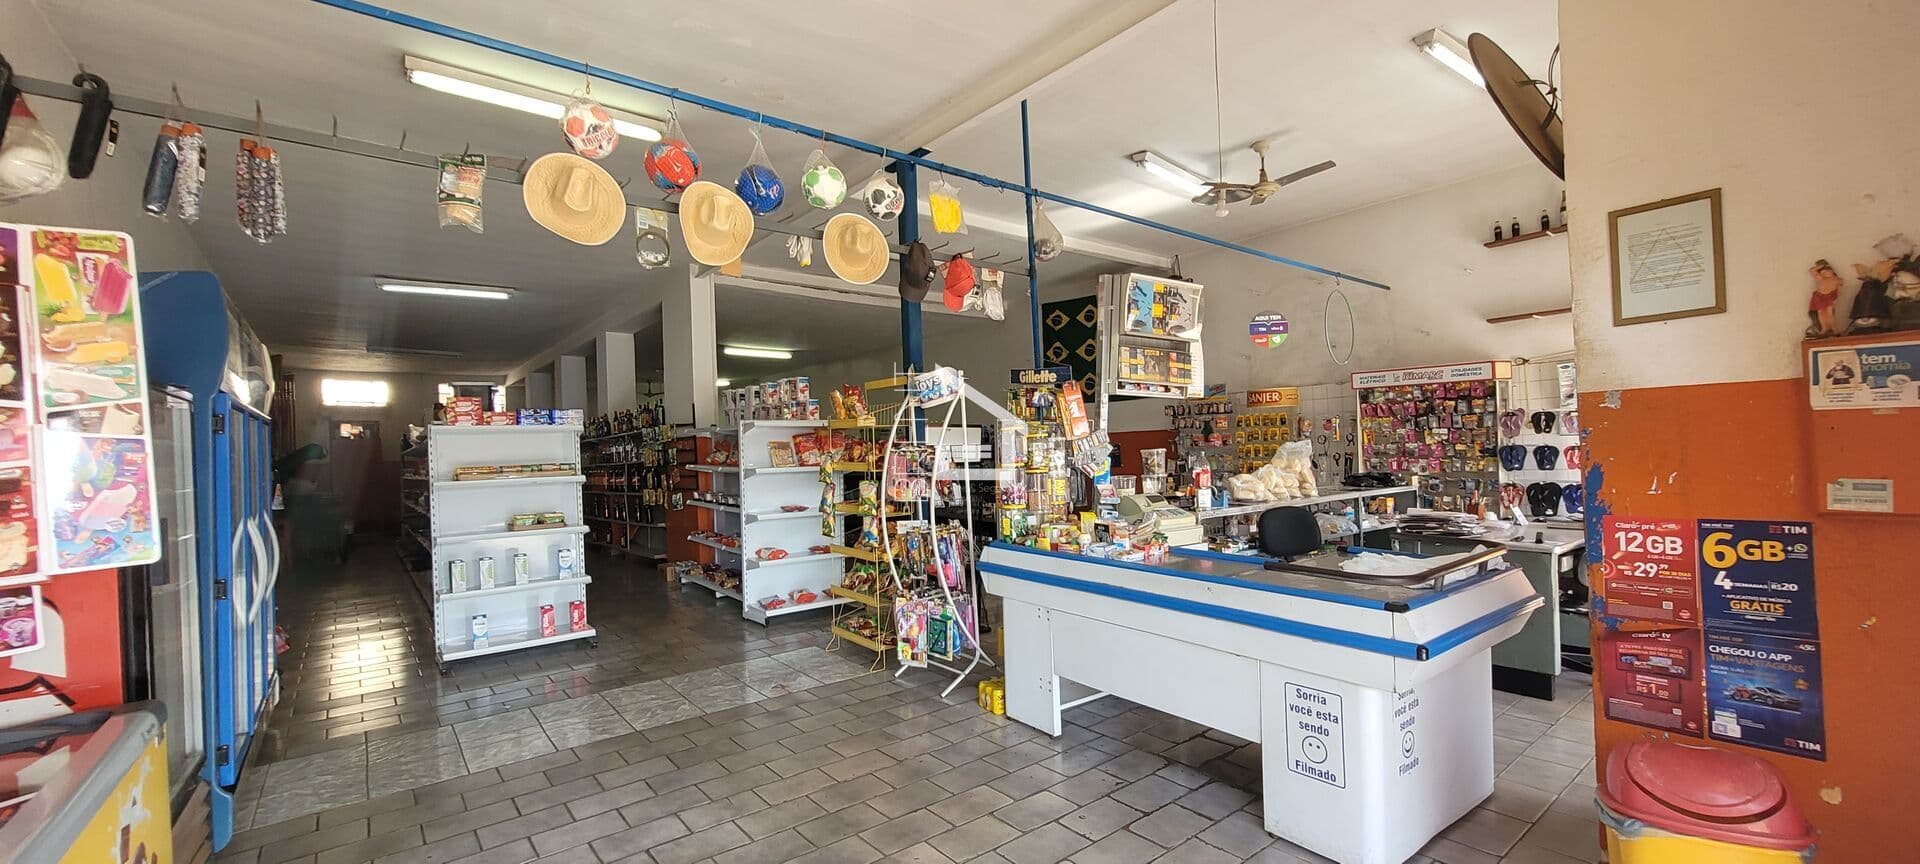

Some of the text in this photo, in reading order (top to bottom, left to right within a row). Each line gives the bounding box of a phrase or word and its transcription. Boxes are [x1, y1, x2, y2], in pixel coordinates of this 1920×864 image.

[1861, 353, 1896, 365] tem
[914, 375, 942, 392] Toys
[1019, 369, 1057, 384] Gillette
[1641, 523, 1656, 531] pré
[1782, 525, 1808, 534] TIM
[1714, 570, 1734, 590] 4
[1709, 645, 1793, 662] CHEGOU O APP
[1295, 688, 1327, 705] Sorria
[1289, 703, 1339, 724] você esta
[1298, 720, 1330, 737] sendo
[1797, 740, 1821, 751] TIM
[1295, 760, 1337, 783] Filmado
